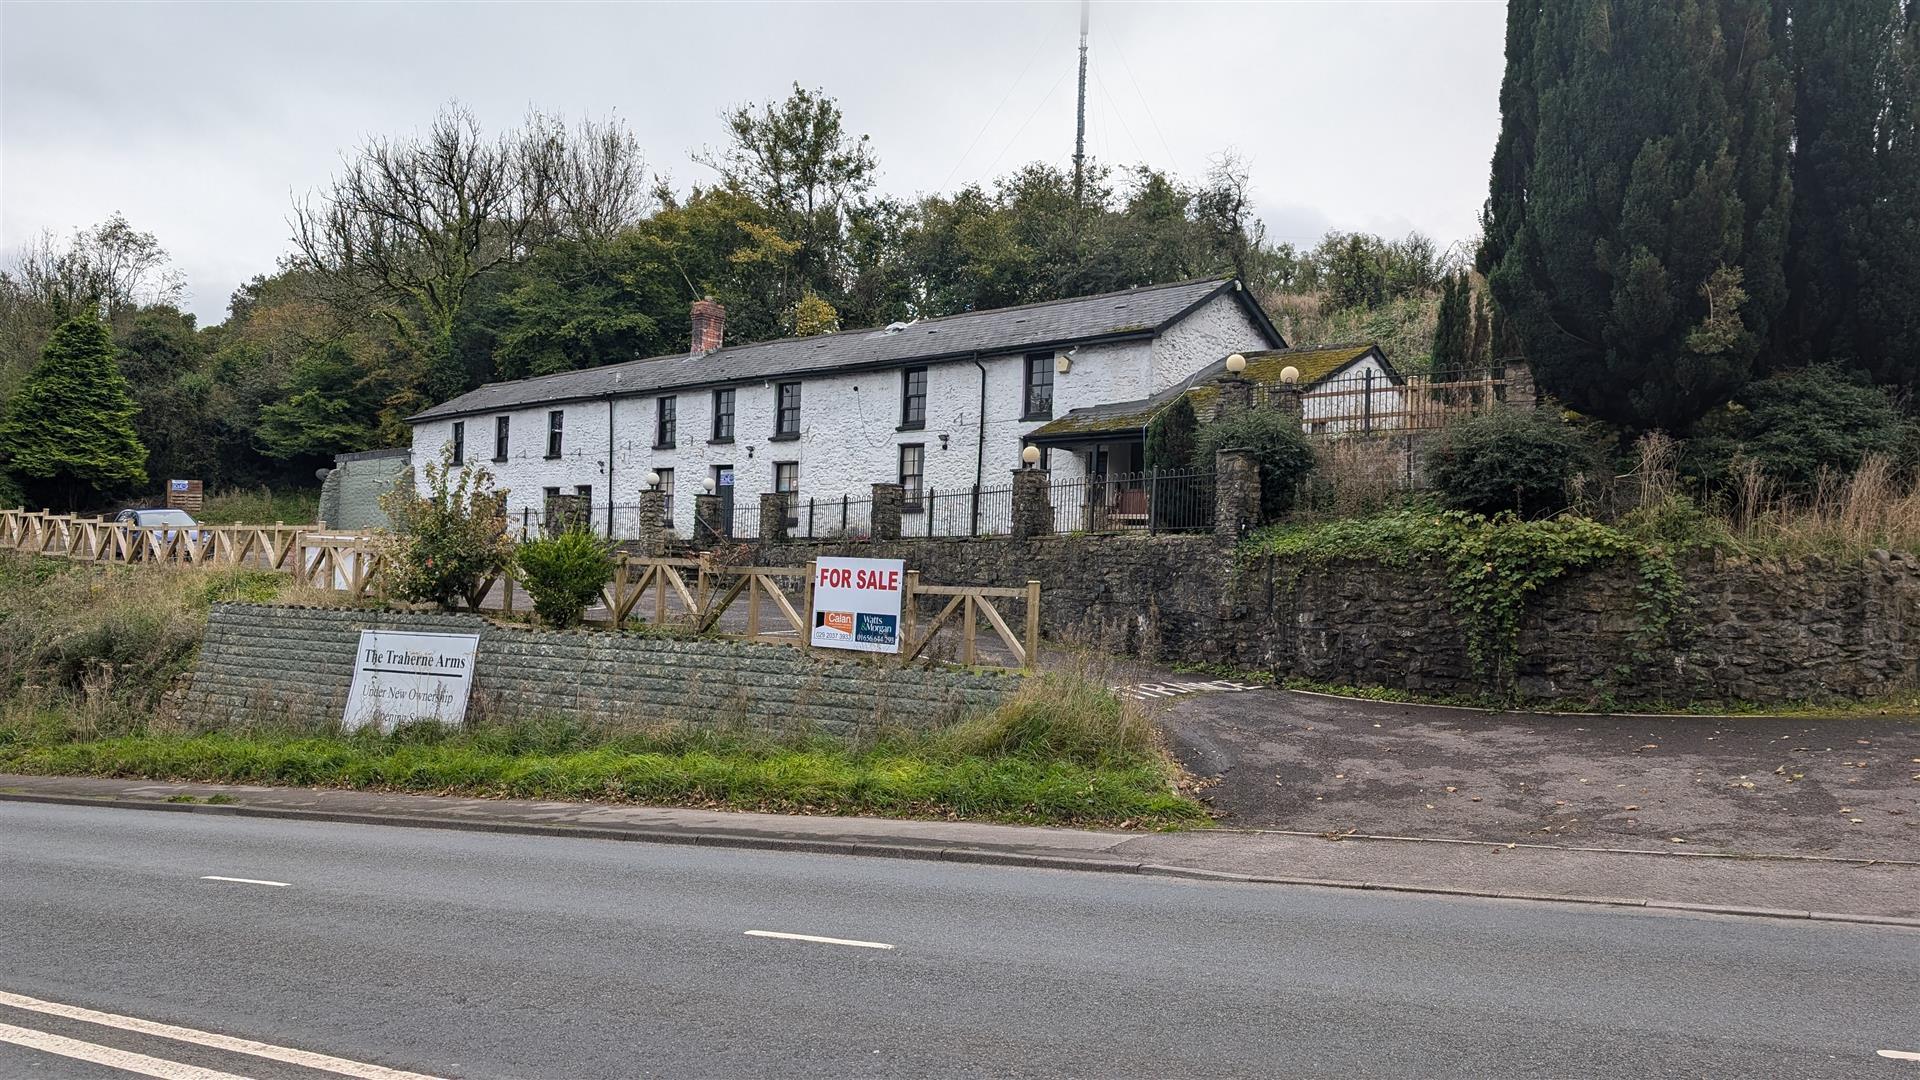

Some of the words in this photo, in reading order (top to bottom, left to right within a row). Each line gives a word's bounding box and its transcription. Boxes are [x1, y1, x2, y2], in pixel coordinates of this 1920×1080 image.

[820, 568, 852, 589] FOR
[857, 570, 898, 591] SALE
[828, 613, 852, 624] Calan
[863, 615, 883, 624] Watts
[365, 649, 383, 664] The
[387, 650, 433, 667] Traherne
[436, 654, 466, 669] Arms
[362, 684, 386, 698] Under
[388, 686, 407, 699] New
